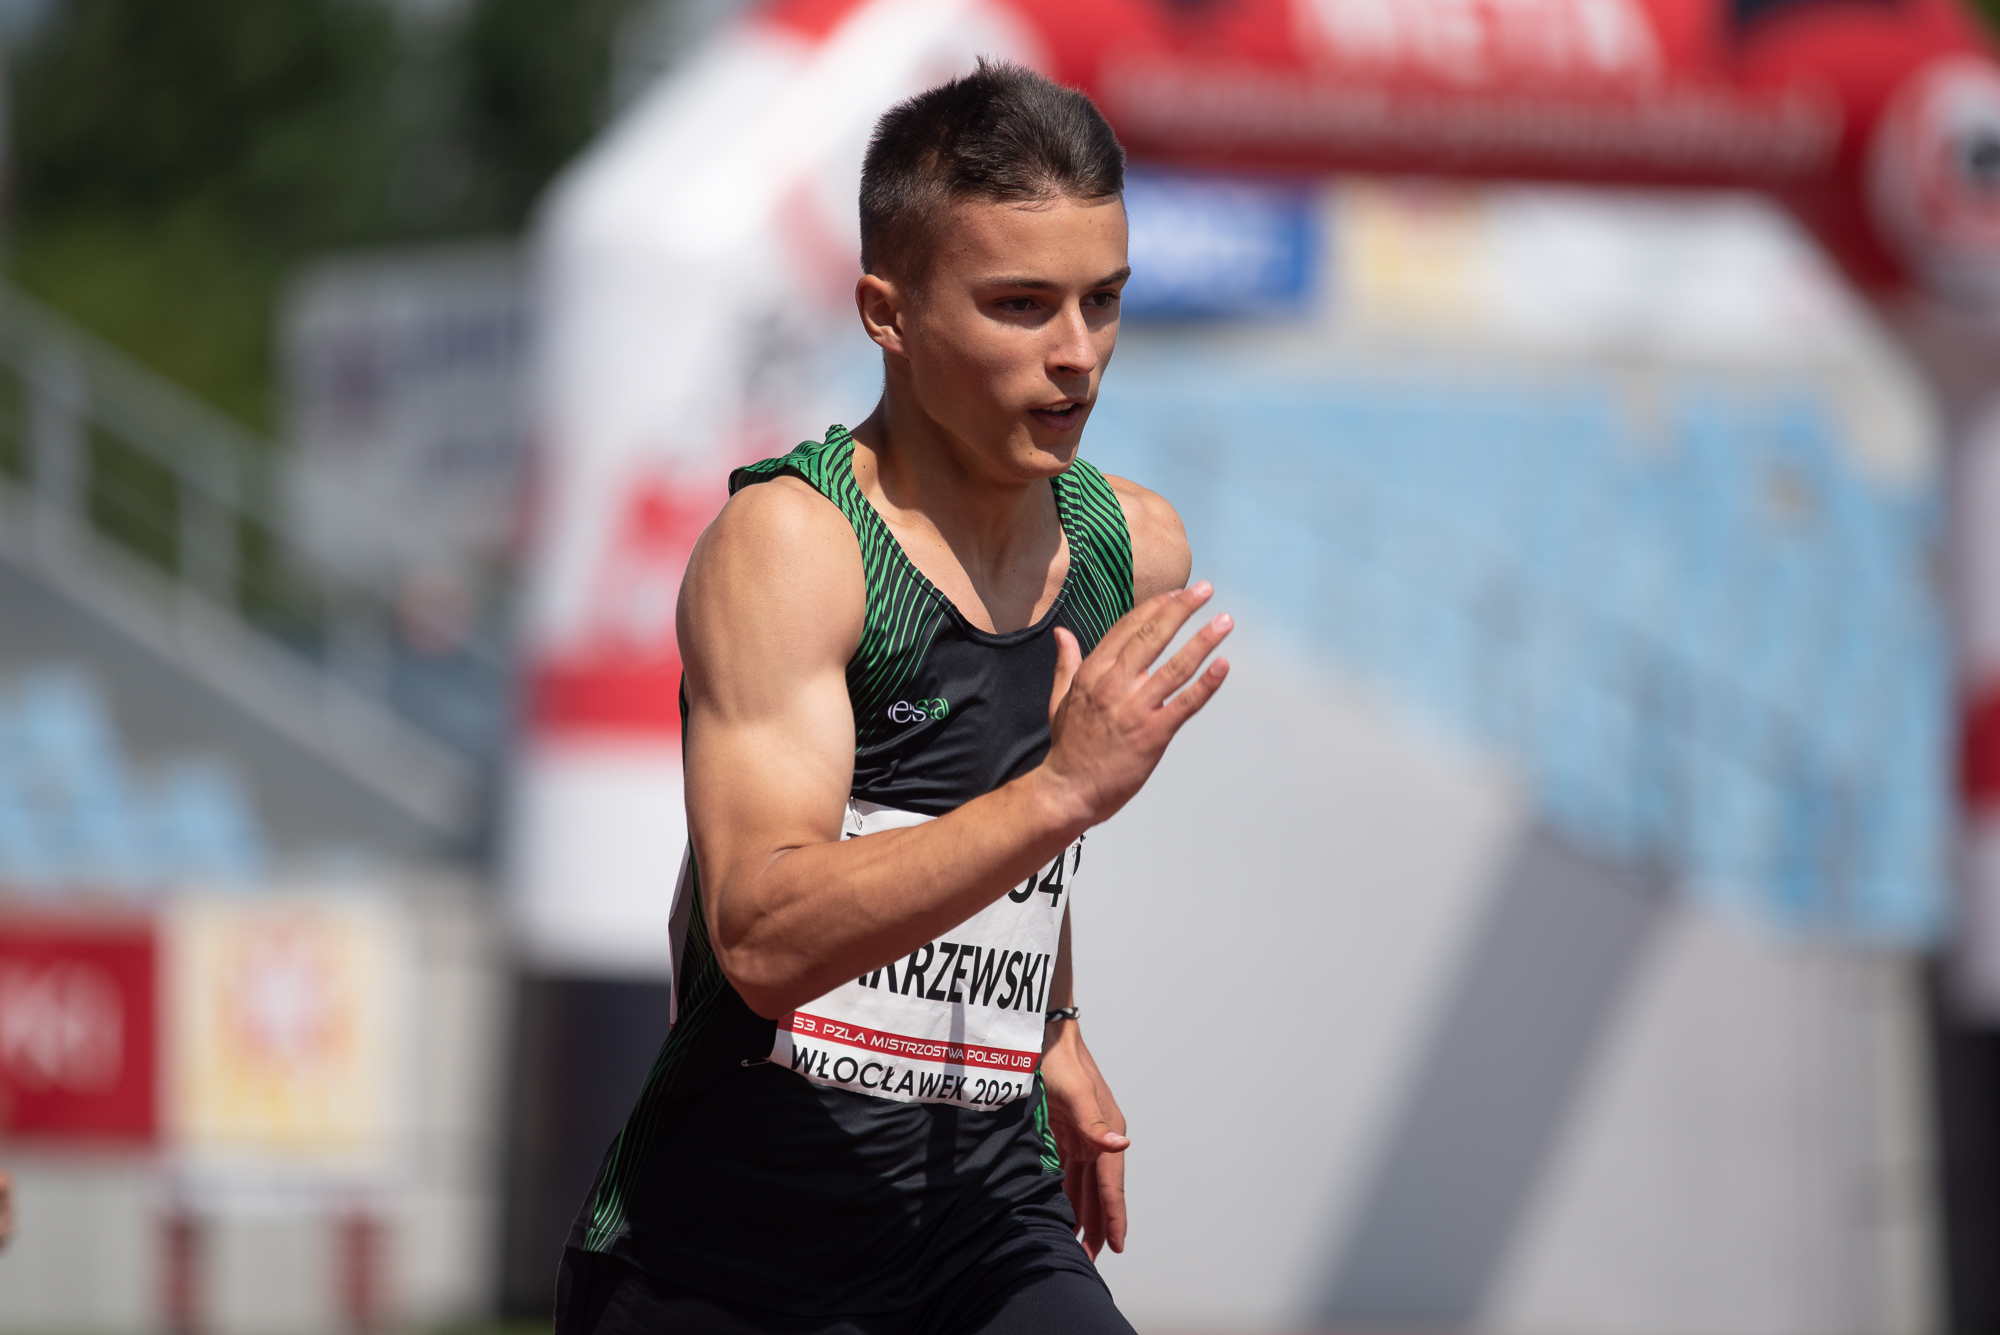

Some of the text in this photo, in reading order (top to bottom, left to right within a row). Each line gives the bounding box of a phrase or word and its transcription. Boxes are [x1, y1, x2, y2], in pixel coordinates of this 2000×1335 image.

[887, 697, 950, 723] esa
[858, 941, 1050, 1013] RZEWSKI
[793, 1016, 1032, 1068] 53. PZLA MISTRZOSTWA POLSKI U18
[790, 1043, 1023, 1106] WŁOCŁAWEK 2021
